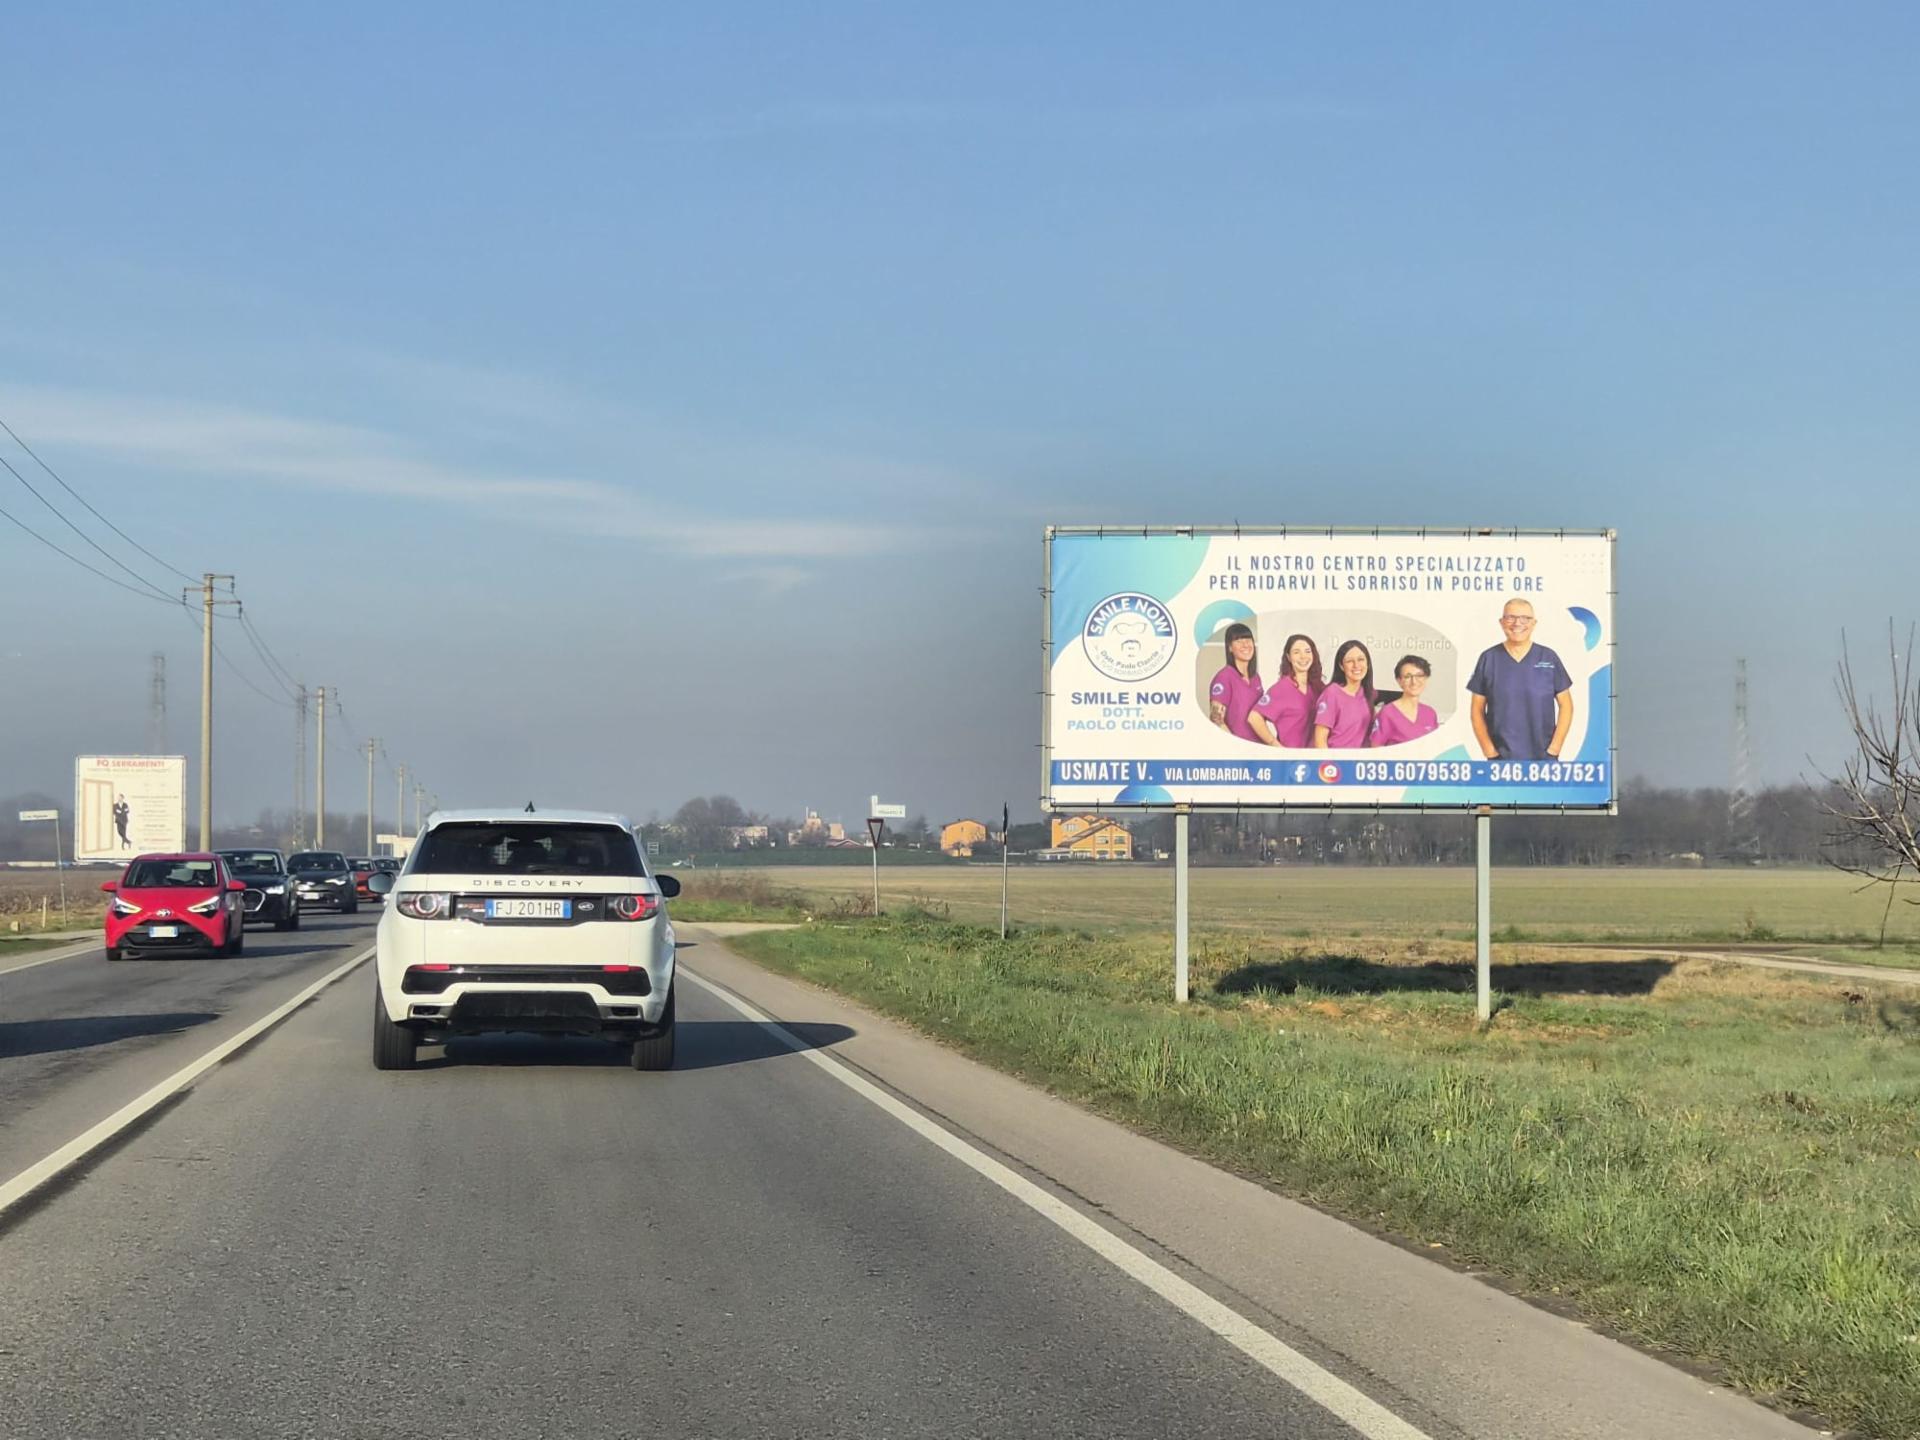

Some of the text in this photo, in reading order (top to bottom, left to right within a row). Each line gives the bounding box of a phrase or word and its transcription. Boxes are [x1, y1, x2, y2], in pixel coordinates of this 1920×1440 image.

[1227, 556, 1526, 572] IL NOSTRO CENTRO SPECIALIZZATO
[1209, 575, 1544, 592] PER RIDARVI IL SORRISO IN POCHE ORE
[1090, 598, 1171, 635] SMILE NOW
[1071, 692, 1181, 705] SMILE NOW
[1102, 707, 1145, 718] DOTT.
[1067, 720, 1184, 730] PAOLO CIANCIO
[1061, 762, 1271, 782] USMATE V. VIA LOMBARDIA, 46
[1355, 762, 1472, 781] 039.6079538
[1490, 763, 1605, 782] 346.8437521
[473, 879, 584, 887] DISCOVERY
